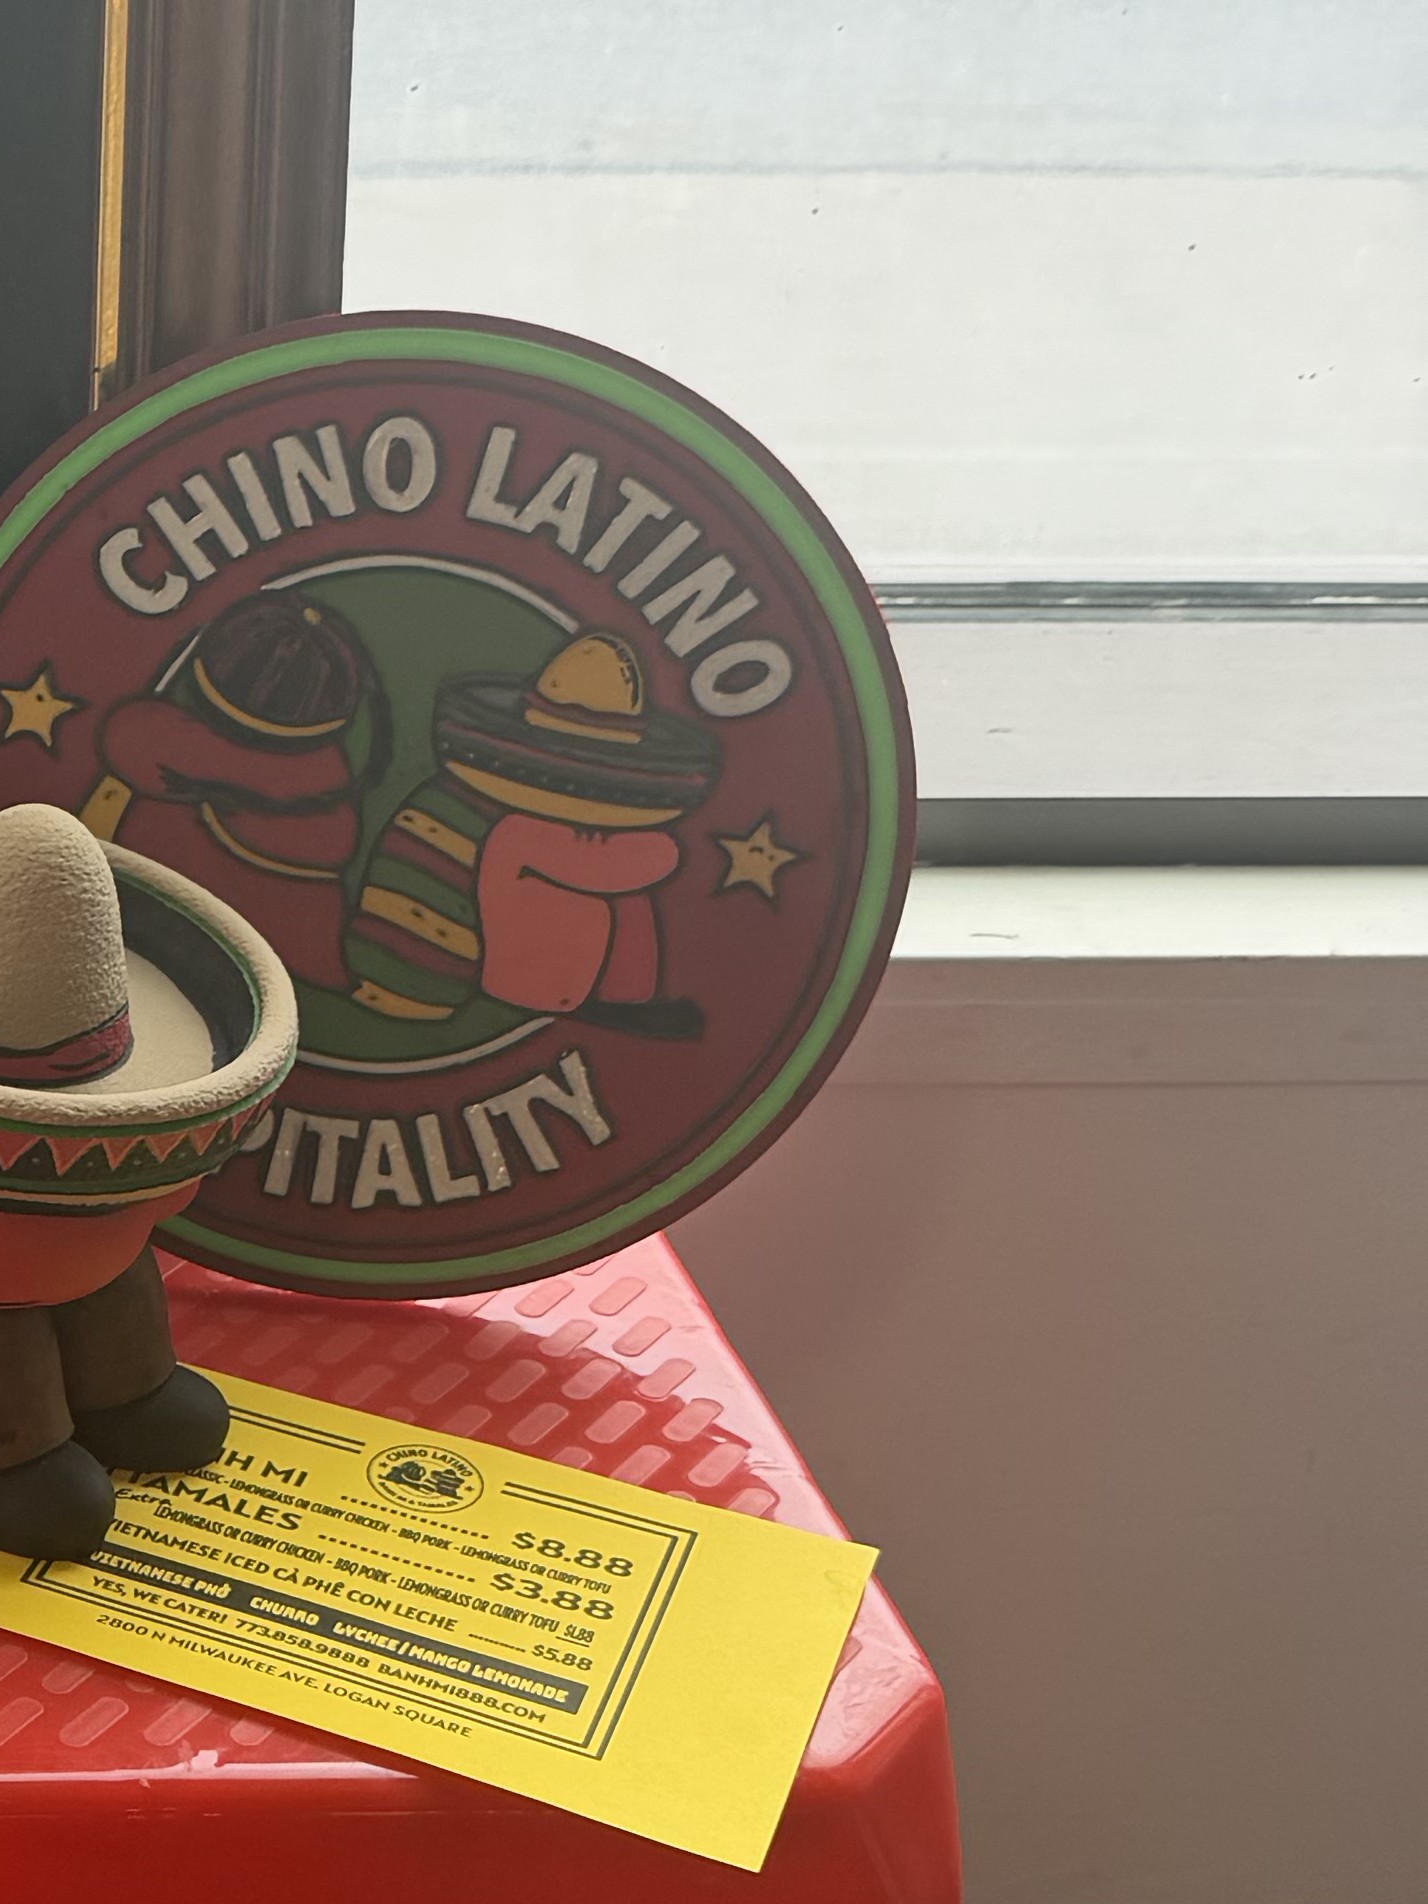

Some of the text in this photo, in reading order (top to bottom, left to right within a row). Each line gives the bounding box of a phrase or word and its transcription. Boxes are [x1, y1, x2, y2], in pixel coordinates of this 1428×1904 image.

[99, 415, 793, 720] CHINO LATINO
[115, 1488, 172, 1506] Extra
[333, 1557, 359, 1577] BBQ
[358, 1564, 391, 1584] PORK
[397, 1576, 472, 1609] LEMONGRASS
[472, 1596, 490, 1613] OR
[489, 1602, 528, 1625] CURRY
[527, 1612, 560, 1633] TOFU
[261, 1460, 634, 1578] MI $8.88
[398, 1528, 421, 1543] BBQ
[421, 1534, 452, 1550] PORK
[582, 1577, 611, 1594] TOFU
[93, 1576, 126, 1597] YES,
[133, 1588, 161, 1604] WE
[163, 1598, 228, 1624] CATER!
[236, 1617, 370, 1669] 773.858.9888
[223, 1552, 270, 1576] ICED
[346, 1589, 392, 1612] CON
[394, 1602, 458, 1633] LECHE
[531, 1644, 593, 1672] $5.88
[490, 1573, 615, 1620] $3.88
[96, 1614, 473, 1738] 2800 N MILWAUKEE AVE. LOGAN SQUARE
[471, 1664, 569, 1703] LEMONADE
